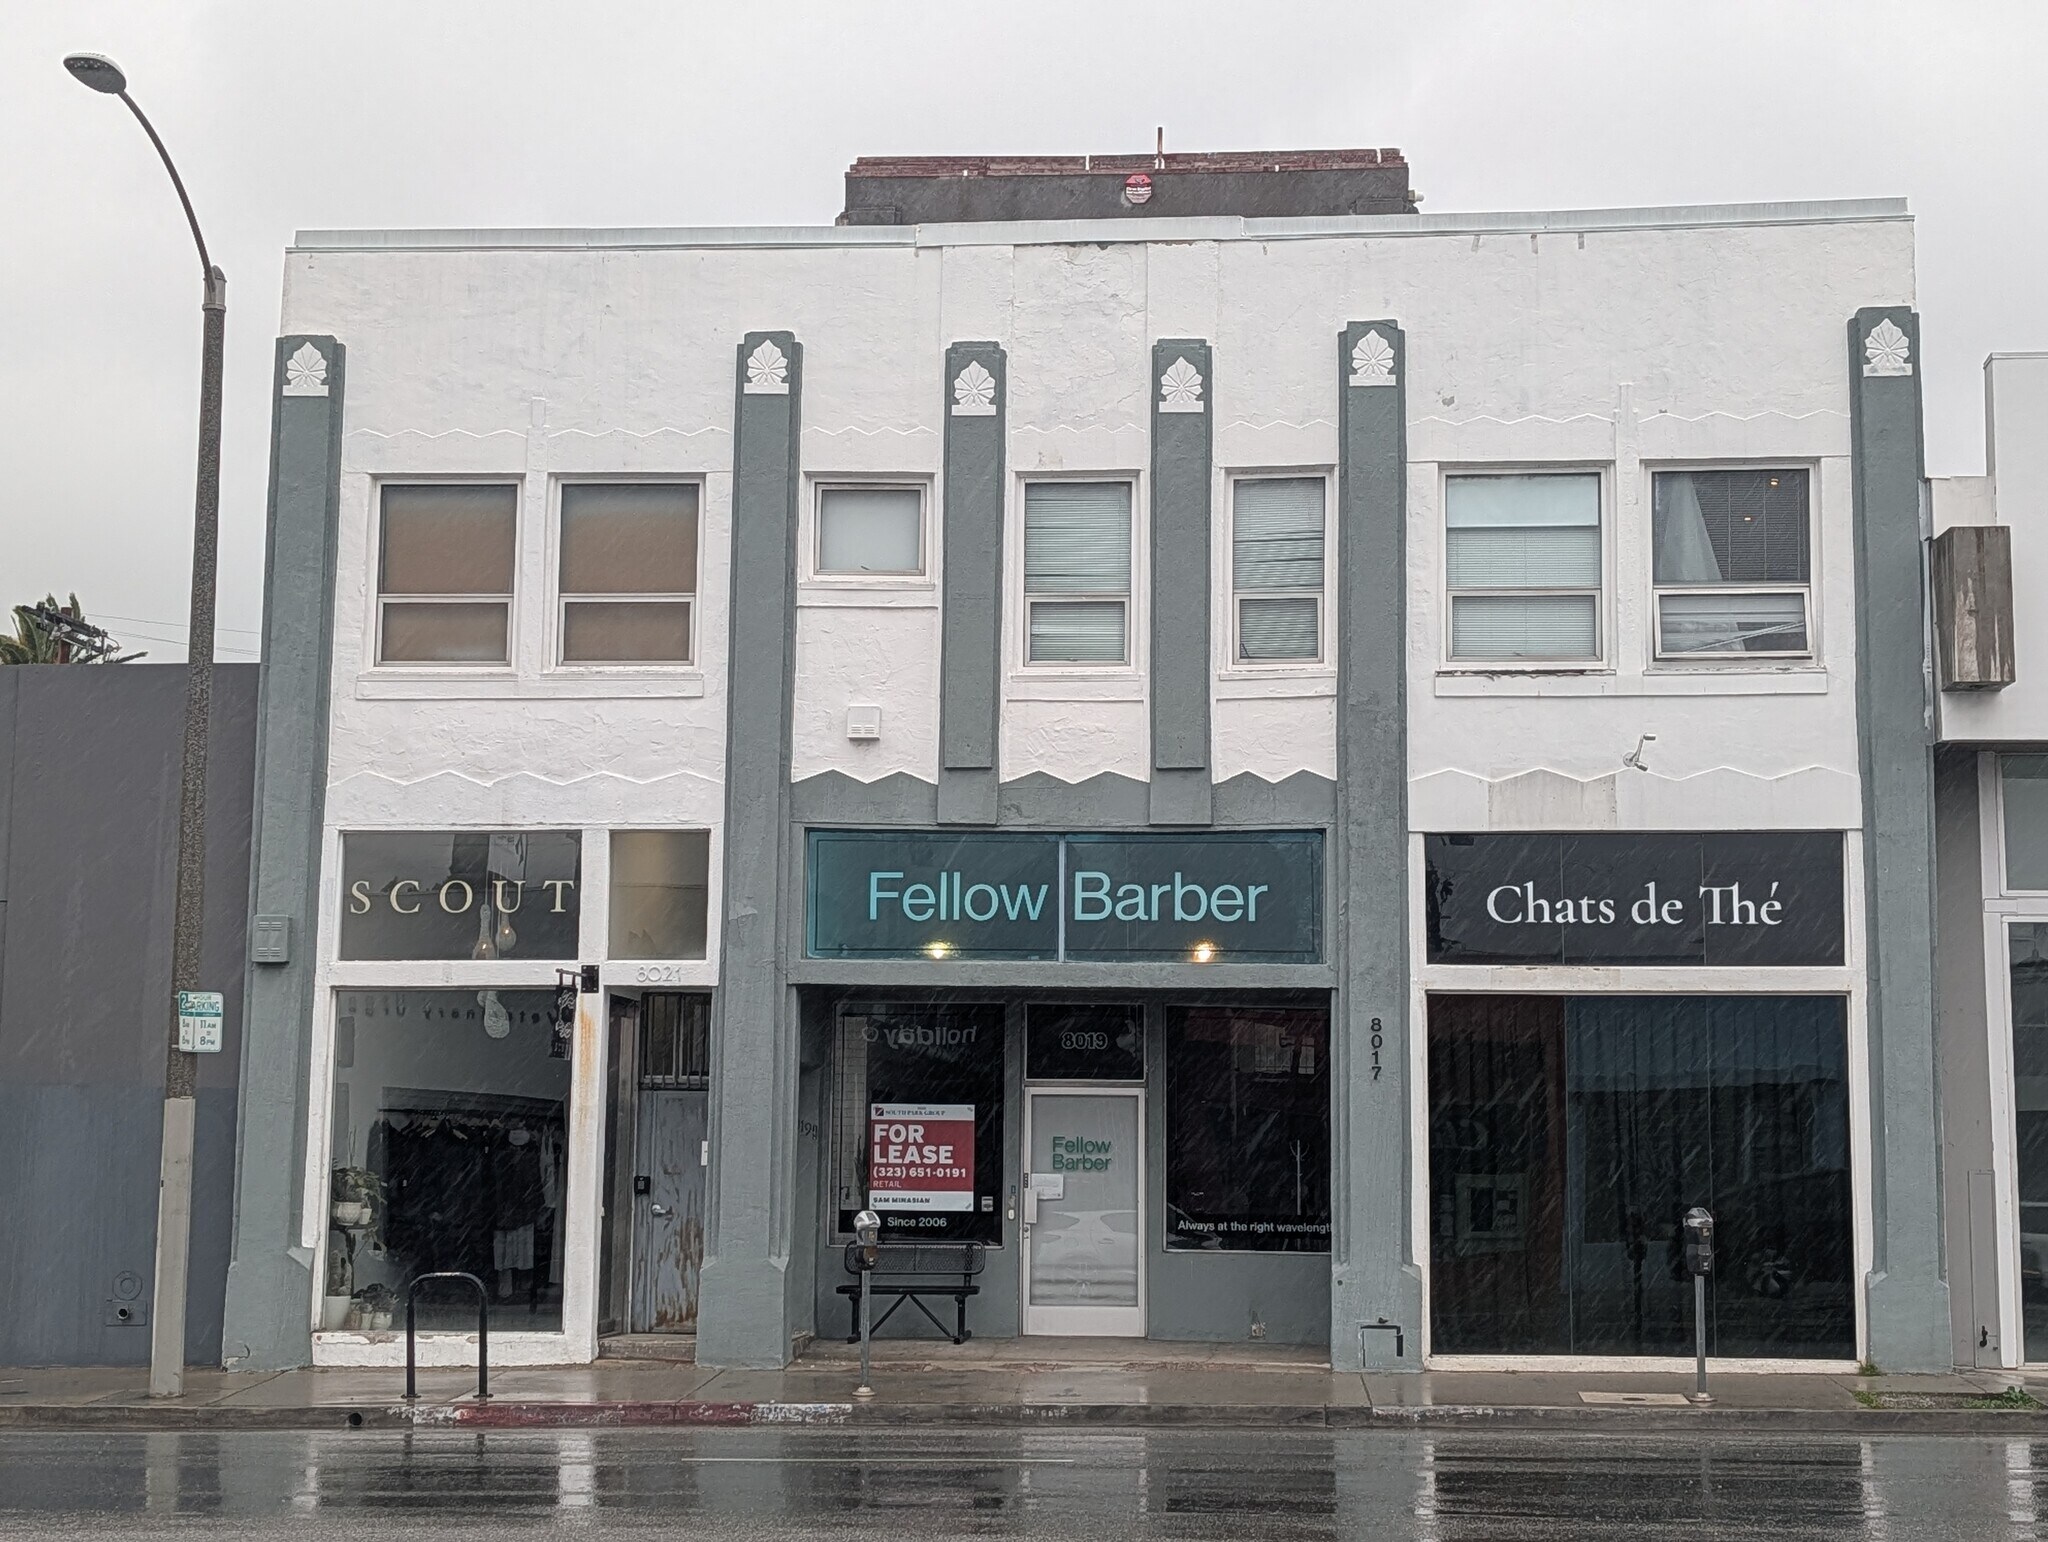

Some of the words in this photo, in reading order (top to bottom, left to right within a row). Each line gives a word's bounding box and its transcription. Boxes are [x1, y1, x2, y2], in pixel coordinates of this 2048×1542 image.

[350, 880, 575, 914] SCOUT
[869, 872, 1049, 922] Fellow
[1074, 872, 1268, 922] Barber
[1486, 880, 1616, 924] Chats
[1631, 881, 1684, 925] de
[1698, 881, 1783, 925] Thé
[637, 966, 682, 982] 8021
[181, 994, 187, 1009] 2
[1062, 1032, 1108, 1050] 8019
[1370, 1017, 1383, 1080] 8017
[874, 1123, 924, 1143] FOR
[1052, 1136, 1111, 1154] Fellow
[874, 1145, 954, 1164] LEASE
[1052, 1154, 1111, 1171] Barber
[873, 1166, 906, 1178] (323)
[909, 1167, 966, 1178] 651-0191
[873, 1180, 901, 1188] RETAIL
[887, 1217, 916, 1227] Since
[918, 1217, 947, 1227] 2006
[1178, 1220, 1215, 1232] Always
[1217, 1222, 1228, 1231] at
[1231, 1222, 1248, 1231] the
[1250, 1222, 1274, 1233] right
